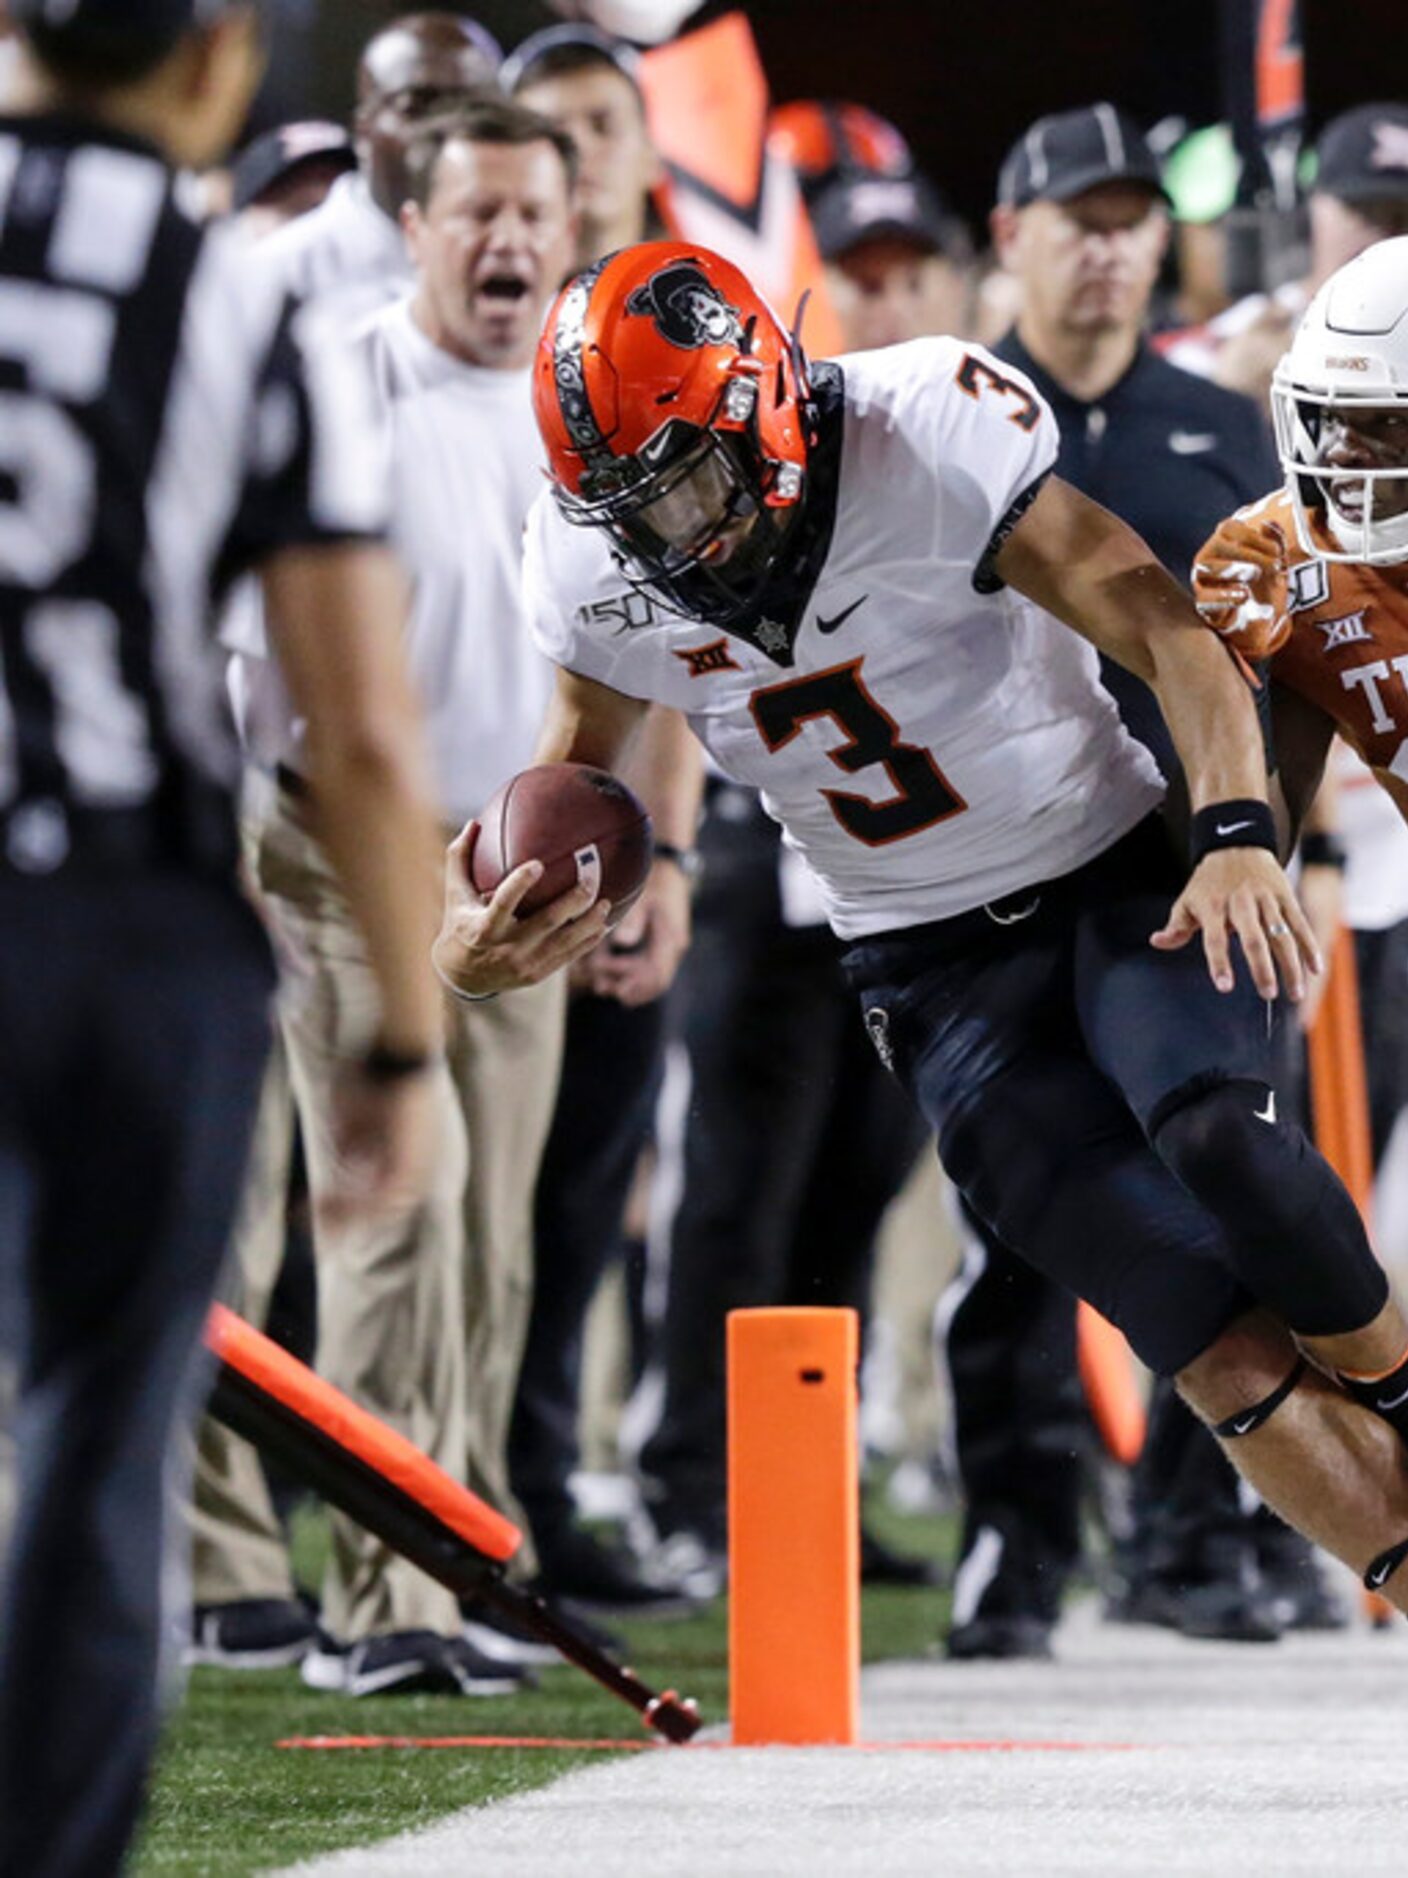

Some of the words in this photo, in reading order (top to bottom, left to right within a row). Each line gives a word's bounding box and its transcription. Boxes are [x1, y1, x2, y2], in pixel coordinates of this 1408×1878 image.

[956, 353, 1041, 433] 3
[1315, 610, 1373, 651] XII
[747, 653, 970, 848] 3
